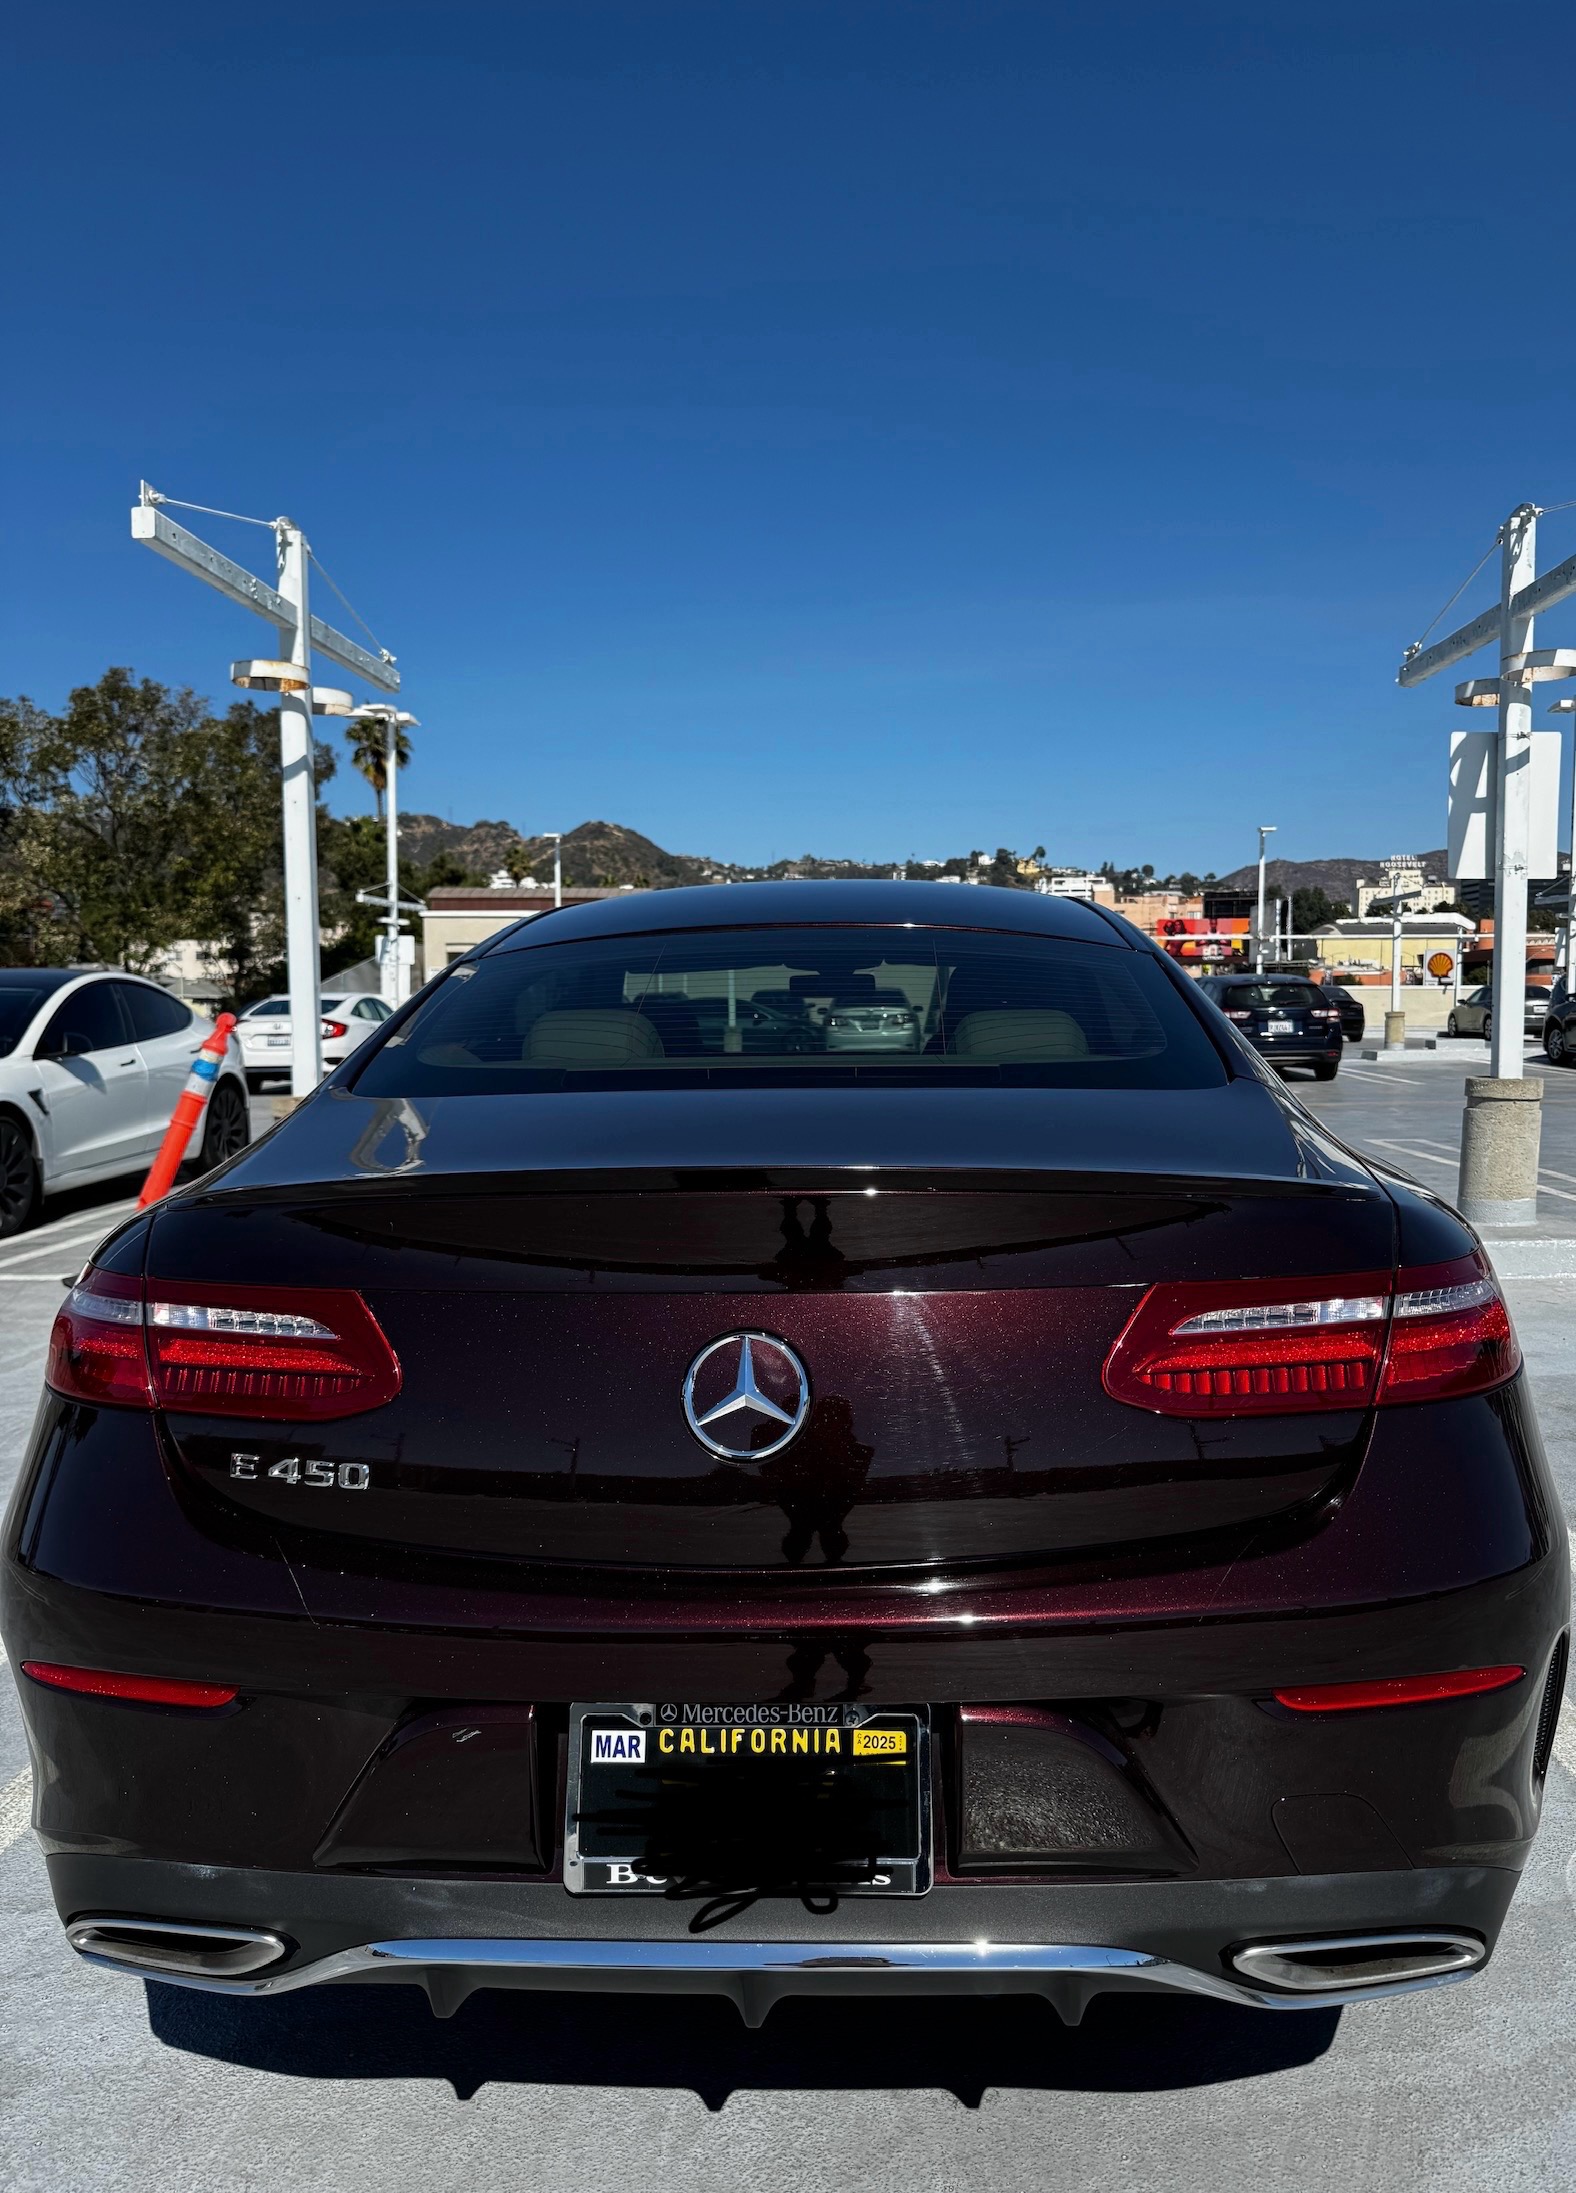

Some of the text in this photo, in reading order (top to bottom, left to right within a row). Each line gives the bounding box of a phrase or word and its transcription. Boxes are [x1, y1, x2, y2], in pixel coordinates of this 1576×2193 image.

[230, 1452, 370, 1490] E 450
[681, 1703, 839, 1724] Mercedes-Benz
[595, 1734, 641, 1759] MAR
[659, 1728, 841, 1754] CALIFORNIA
[863, 1735, 896, 1750] 2025
